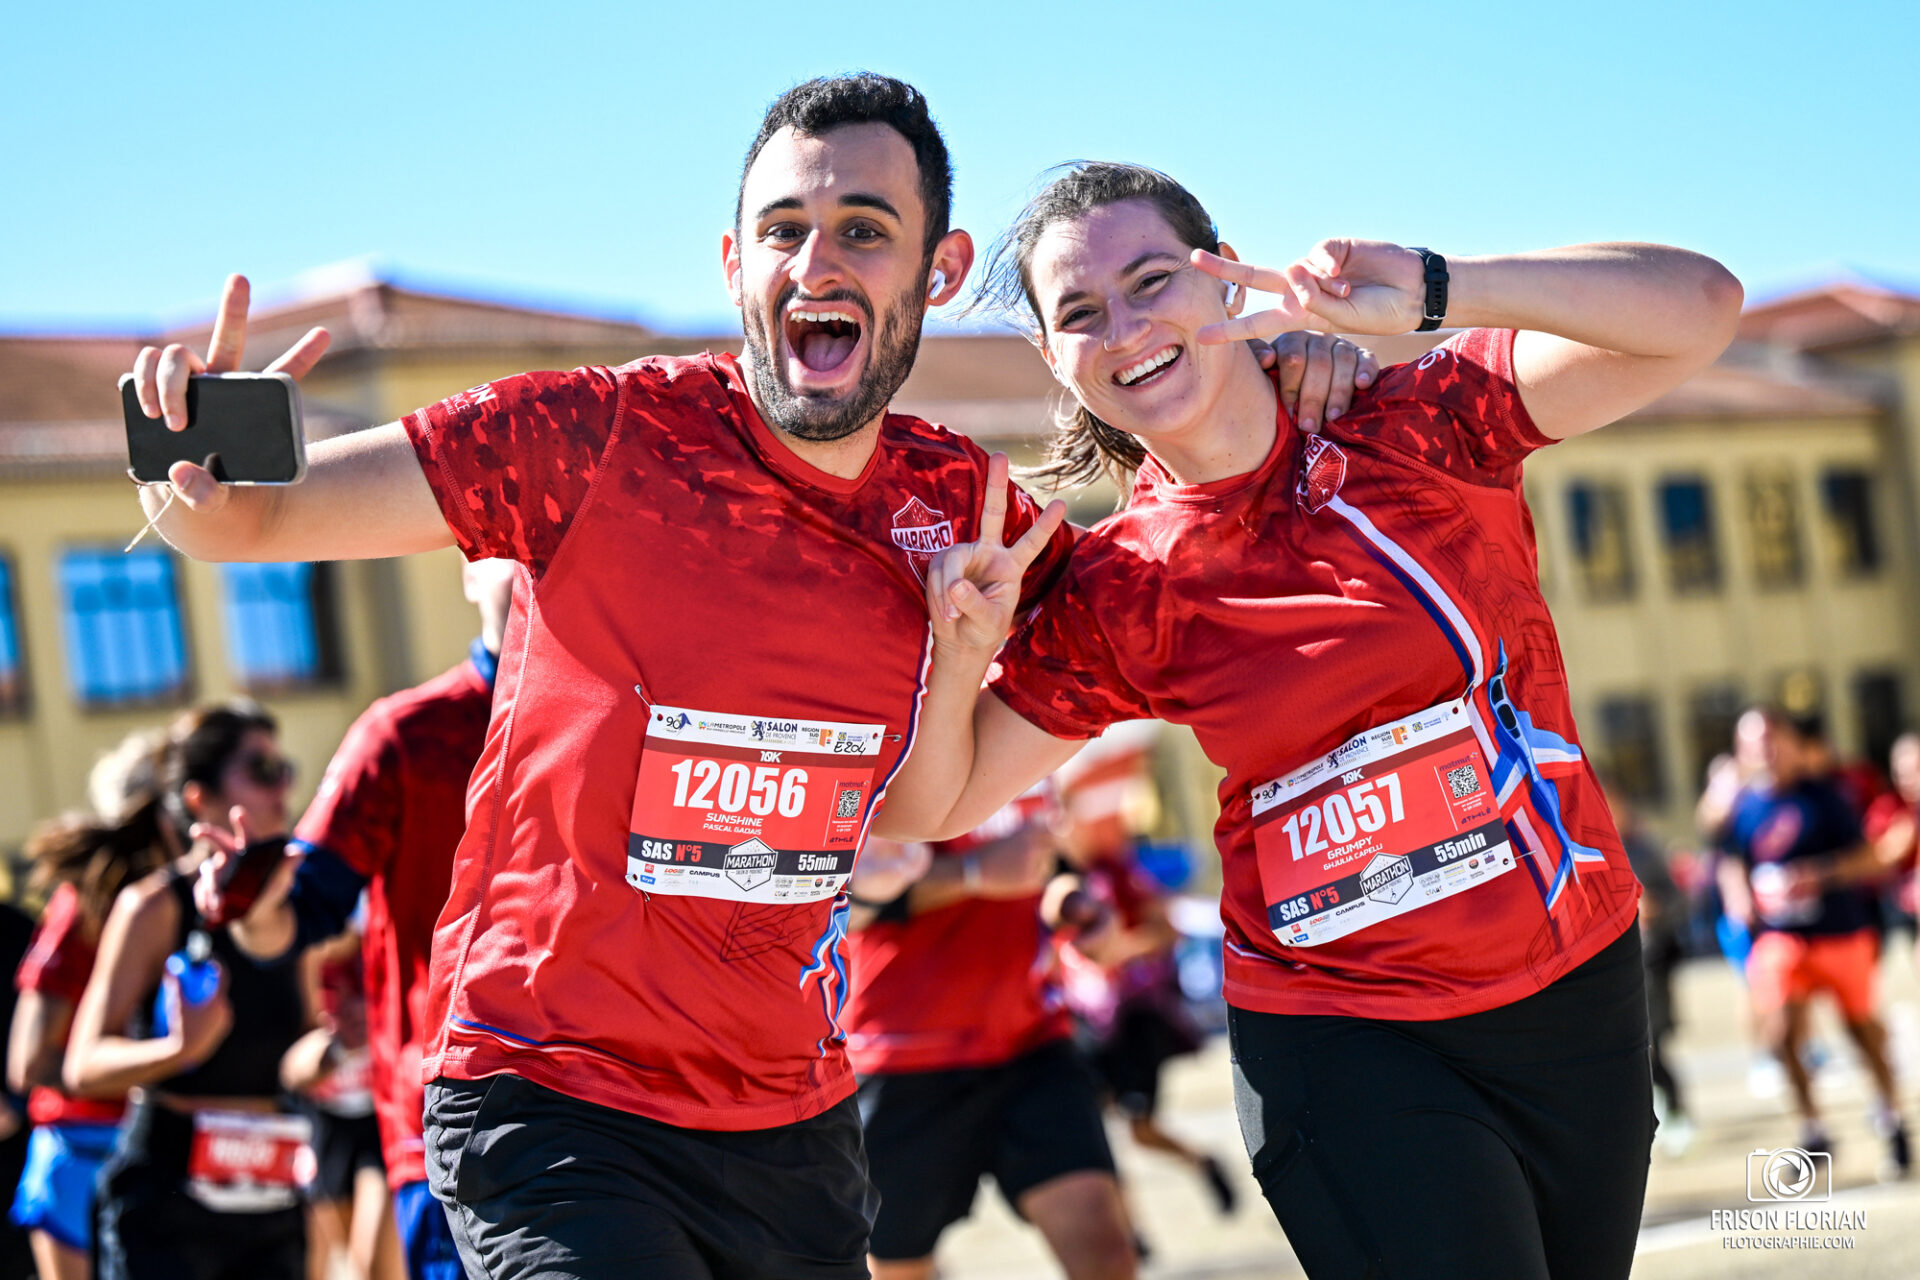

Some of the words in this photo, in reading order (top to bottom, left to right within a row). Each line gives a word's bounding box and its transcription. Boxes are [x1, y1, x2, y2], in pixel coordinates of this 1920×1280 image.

[767, 721, 798, 732] SALON
[1339, 736, 1367, 756] SALON
[760, 750, 782, 763] 10K
[1341, 768, 1365, 786] 10K
[671, 758, 809, 818] 12056
[705, 812, 764, 827] SUNSHINE
[1281, 772, 1405, 862] 12057
[703, 823, 732, 832] PASCAL
[733, 826, 762, 836] GADAIS
[641, 840, 673, 861] SAS
[675, 844, 702, 863] N°5
[1323, 855, 1354, 870] GHJULIA
[1354, 843, 1383, 860] CAPELLI
[1327, 835, 1372, 860] GRUMPY
[1433, 832, 1487, 863] 55min
[726, 854, 776, 869] MARATHON
[798, 854, 838, 871] 55min
[689, 870, 720, 878] CAMPUS
[1362, 859, 1410, 894] MARATHON
[1280, 897, 1310, 922] SAS
[1309, 886, 1340, 911] N°5
[1335, 901, 1366, 916] CAMPUS
